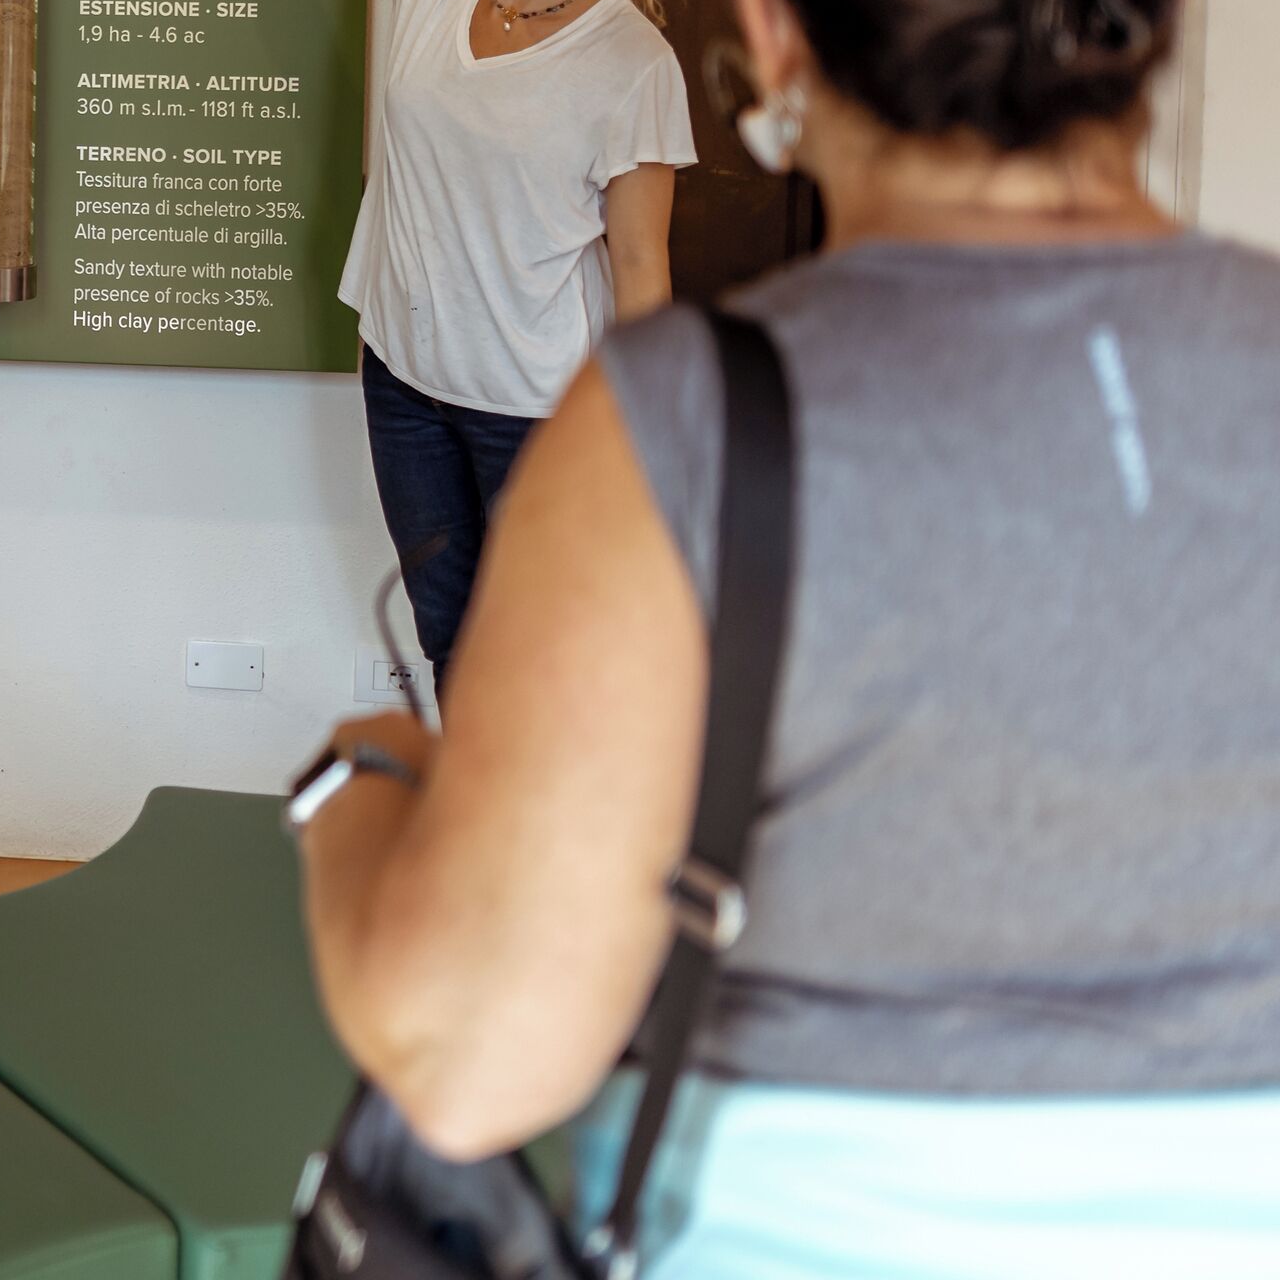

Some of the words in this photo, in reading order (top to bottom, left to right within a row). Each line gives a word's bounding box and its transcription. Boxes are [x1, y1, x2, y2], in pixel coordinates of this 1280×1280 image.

[79, 0, 200, 16] ESTENSIONE
[216, 3, 259, 17] SIZE
[78, 25, 103, 43] 1,9
[110, 26, 130, 42] ha
[149, 27, 178, 42] 4.6
[76, 74, 190, 89] ALTIMETRIA
[205, 76, 300, 91] ALTITUDE
[77, 98, 113, 114] 360
[201, 101, 235, 117] 1181
[242, 102, 254, 117] ft
[260, 103, 301, 118] a.s.l.
[76, 146, 167, 162] TERRENO
[182, 149, 227, 164] SOIL
[232, 150, 282, 165] TYPE
[75, 171, 148, 188] Tessitura
[152, 173, 203, 189] franca
[208, 179, 238, 190] con
[243, 175, 283, 192] forte
[75, 201, 150, 216] presenza
[156, 200, 169, 215] di
[174, 201, 251, 217] scheletro
[255, 202, 305, 219] >35%.
[74, 223, 106, 239] Alta
[111, 227, 209, 243] percentuale
[214, 228, 228, 243] di
[233, 229, 288, 248] argilla.
[74, 258, 126, 279] Sandy
[128, 261, 187, 277] texture
[191, 263, 226, 278] with
[230, 264, 293, 280] notable
[73, 288, 150, 304] presence
[155, 288, 171, 303] of
[175, 289, 220, 304] rocks
[224, 290, 274, 306] >35%.
[73, 311, 113, 331] High
[118, 313, 153, 332] clay
[158, 317, 261, 336] percentage.
